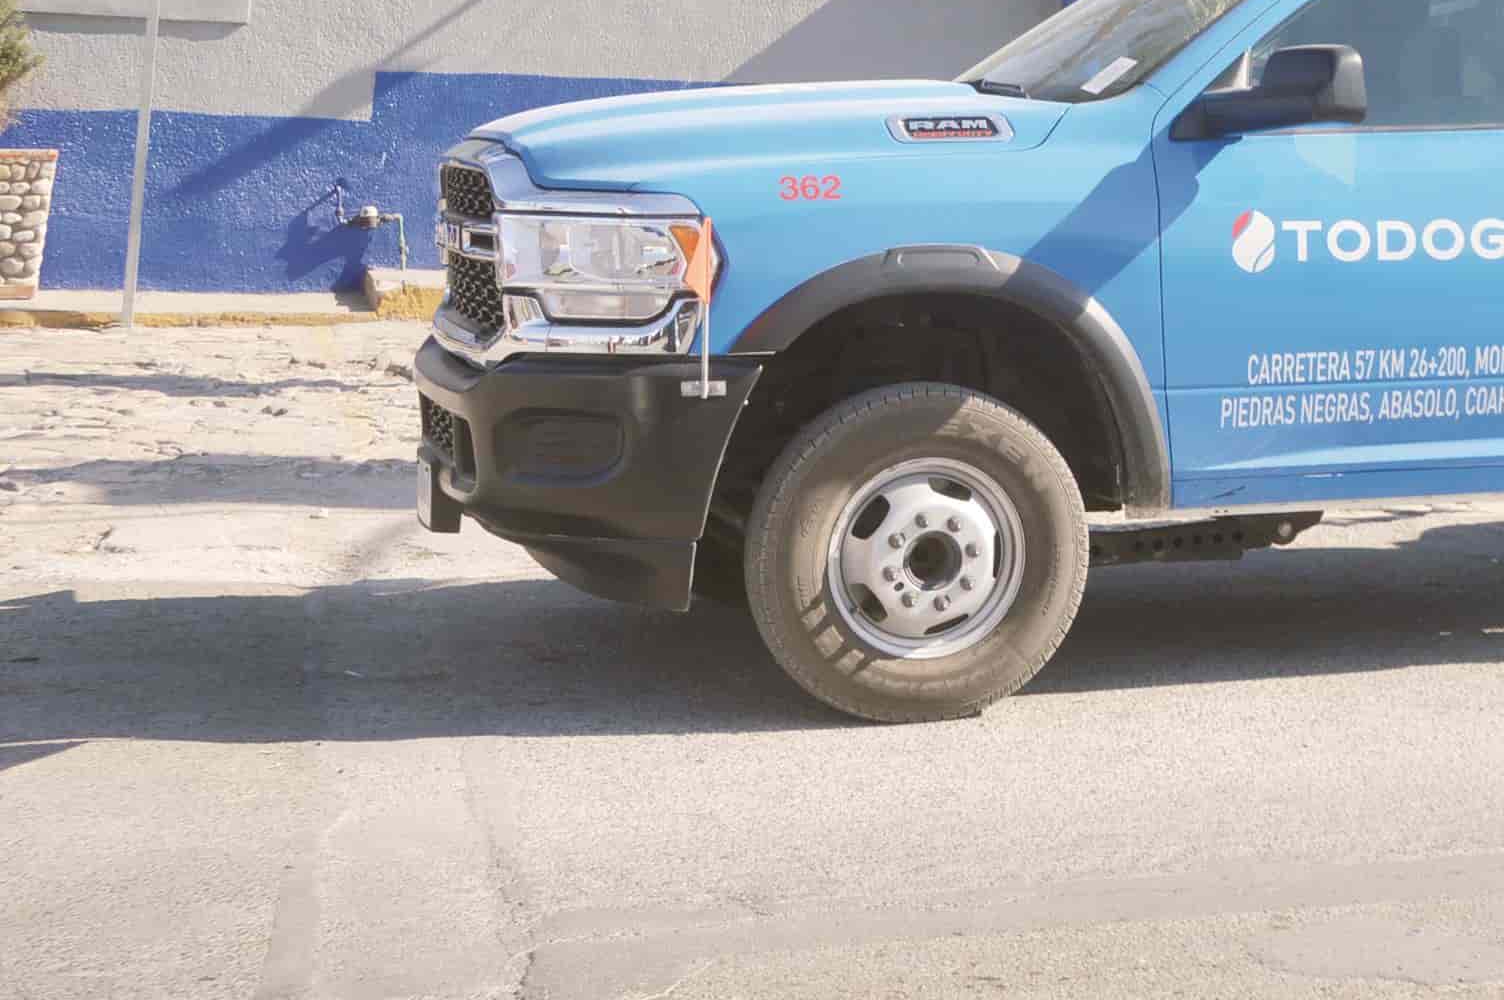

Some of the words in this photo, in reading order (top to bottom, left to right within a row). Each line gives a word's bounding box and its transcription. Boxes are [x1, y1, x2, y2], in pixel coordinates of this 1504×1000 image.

[909, 118, 989, 131] RAM
[779, 175, 841, 200] 362
[1247, 351, 1350, 384] CARRETERA
[1355, 349, 1375, 380] 57
[1378, 348, 1405, 379] KM
[1409, 346, 1470, 379] 26+200,
[1220, 395, 1296, 429] PIEDRAS
[1300, 391, 1374, 424] NEGRAS,
[1378, 386, 1460, 421] ABASOLO,
